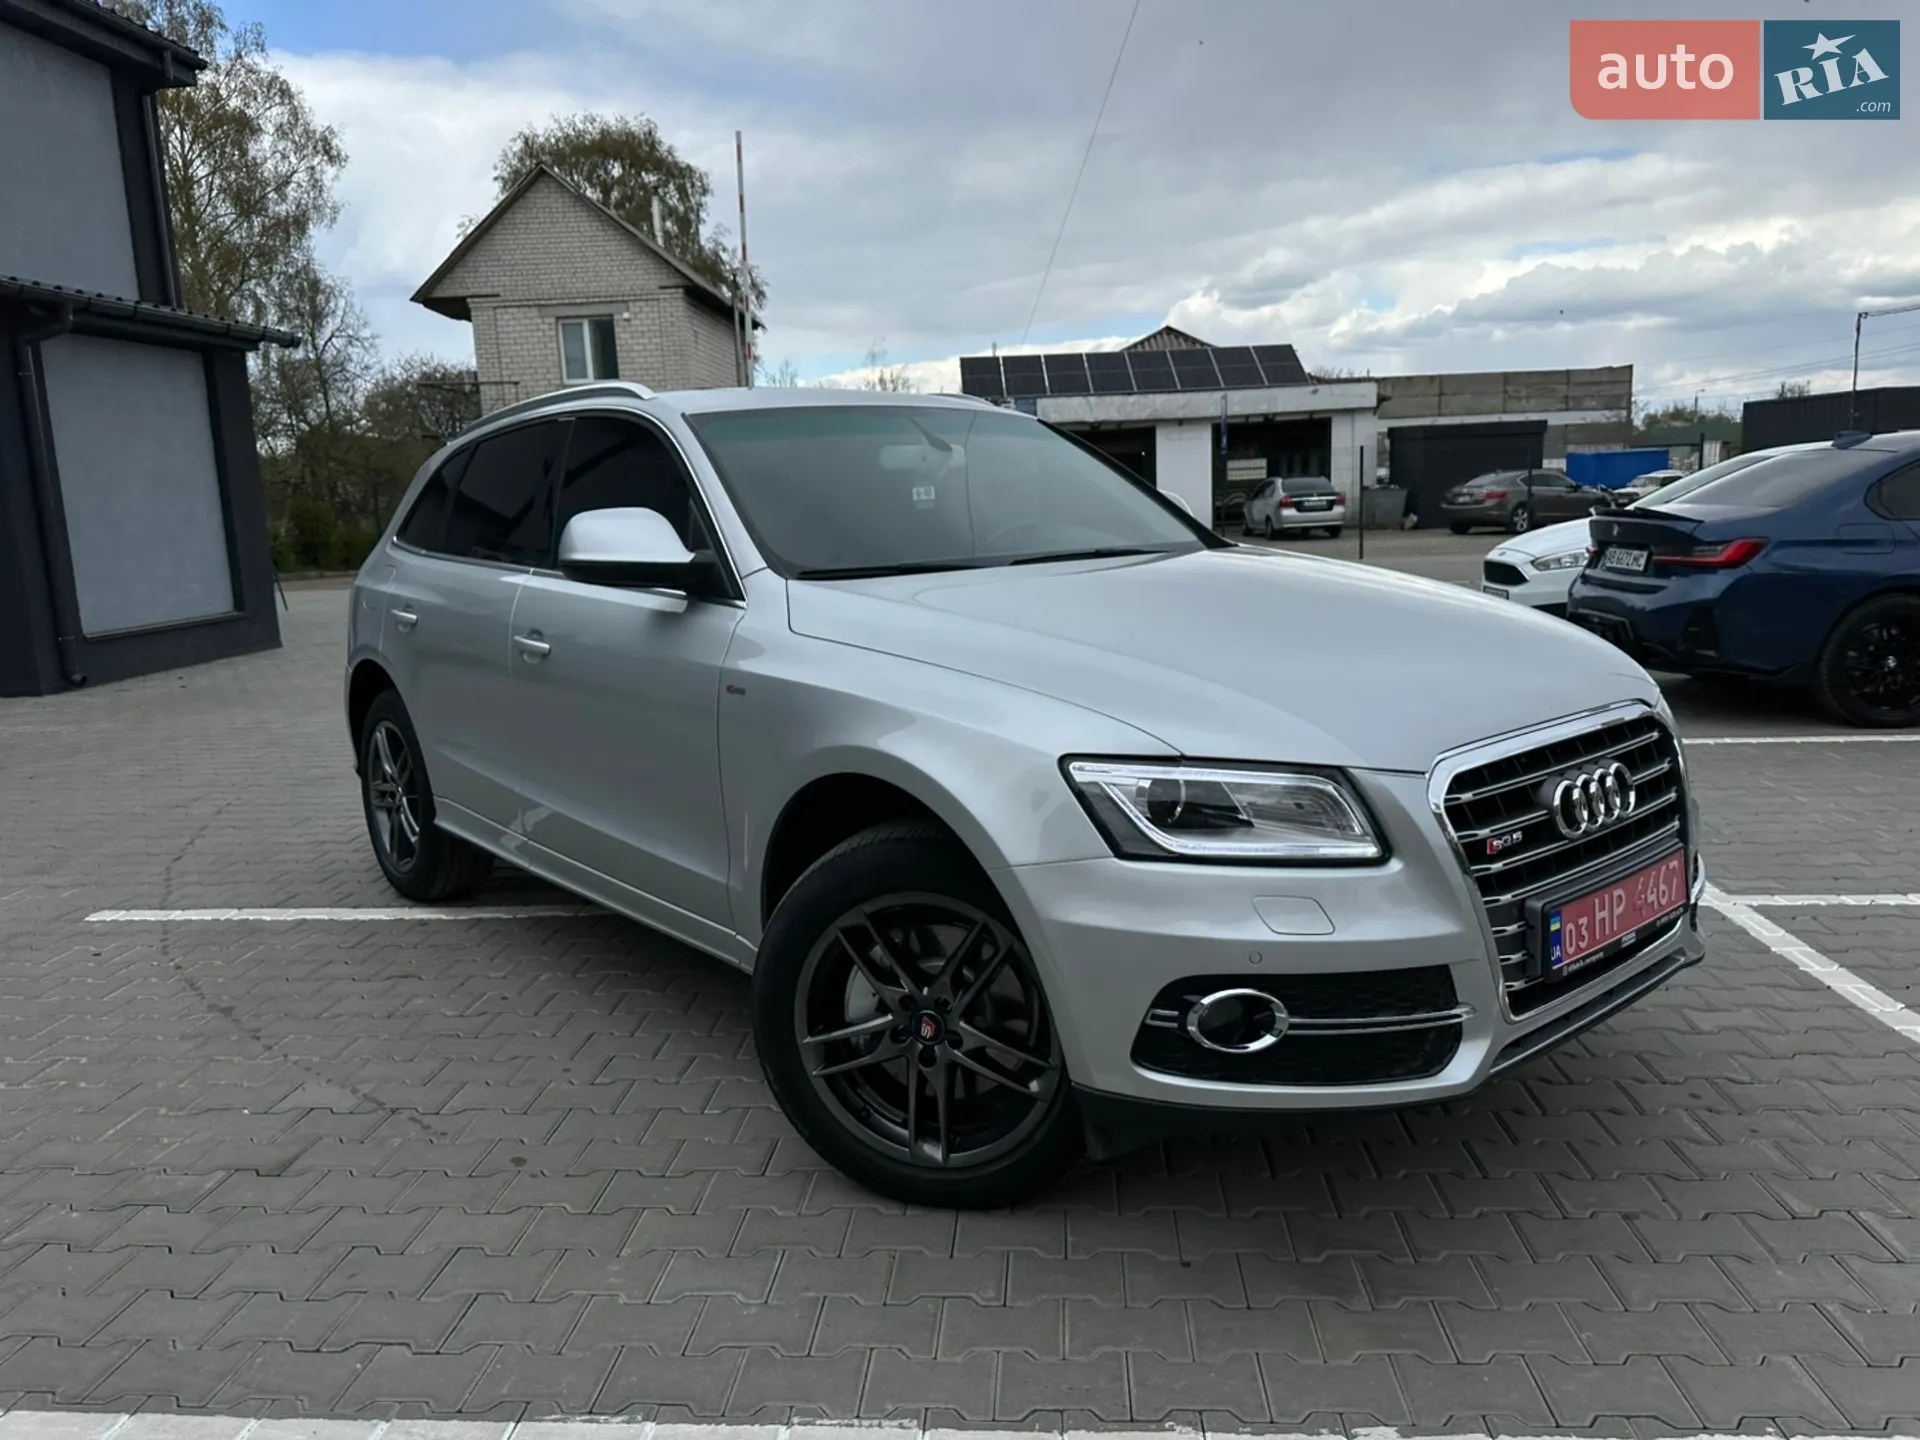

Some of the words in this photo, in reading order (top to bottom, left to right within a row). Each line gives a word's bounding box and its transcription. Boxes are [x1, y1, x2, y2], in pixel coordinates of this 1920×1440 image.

[1565, 916, 1588, 955] 03
[1594, 888, 1626, 940] HP
[1633, 860, 1679, 917] 4467
